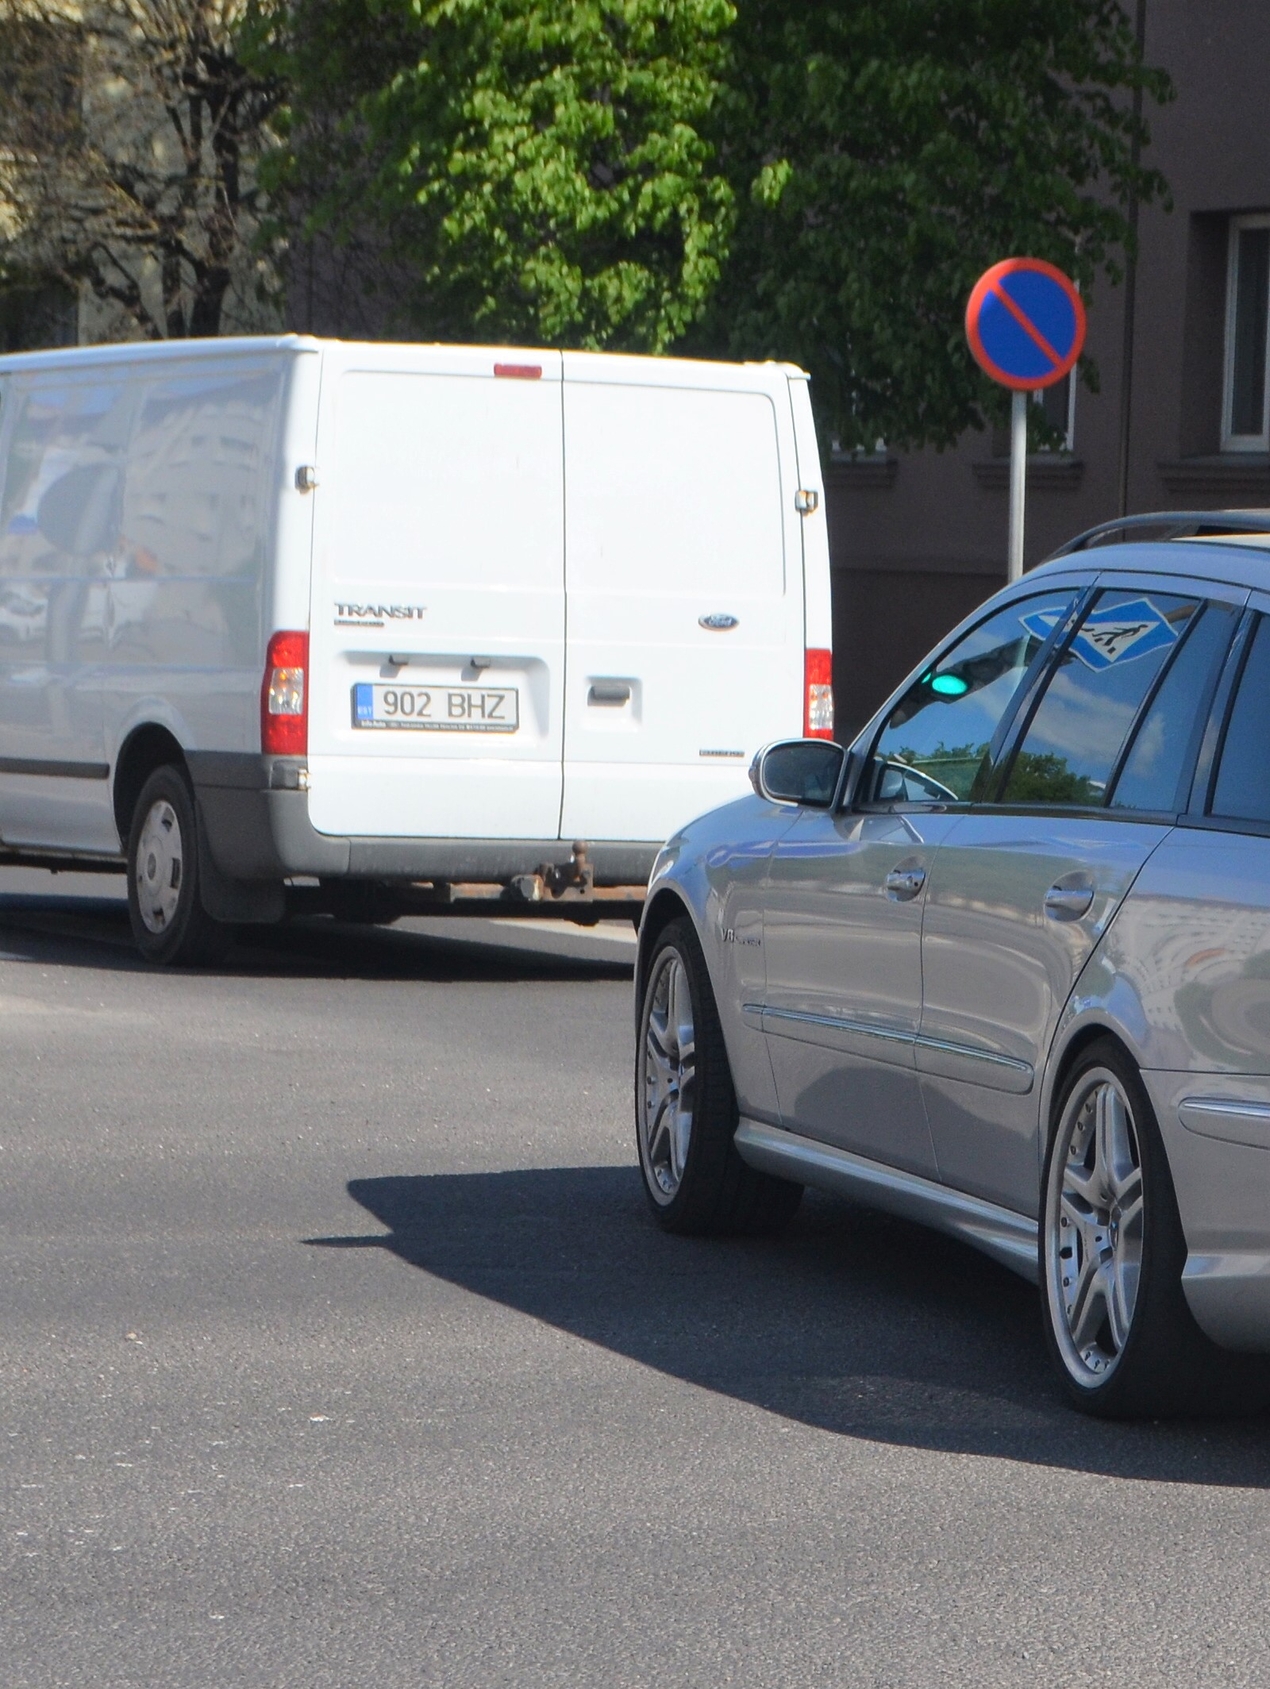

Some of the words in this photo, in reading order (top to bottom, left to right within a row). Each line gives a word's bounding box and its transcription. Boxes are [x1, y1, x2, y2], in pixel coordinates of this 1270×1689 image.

[334, 602, 427, 619] TRANSIT
[383, 692, 432, 718] 902
[448, 693, 506, 720] BHZ
